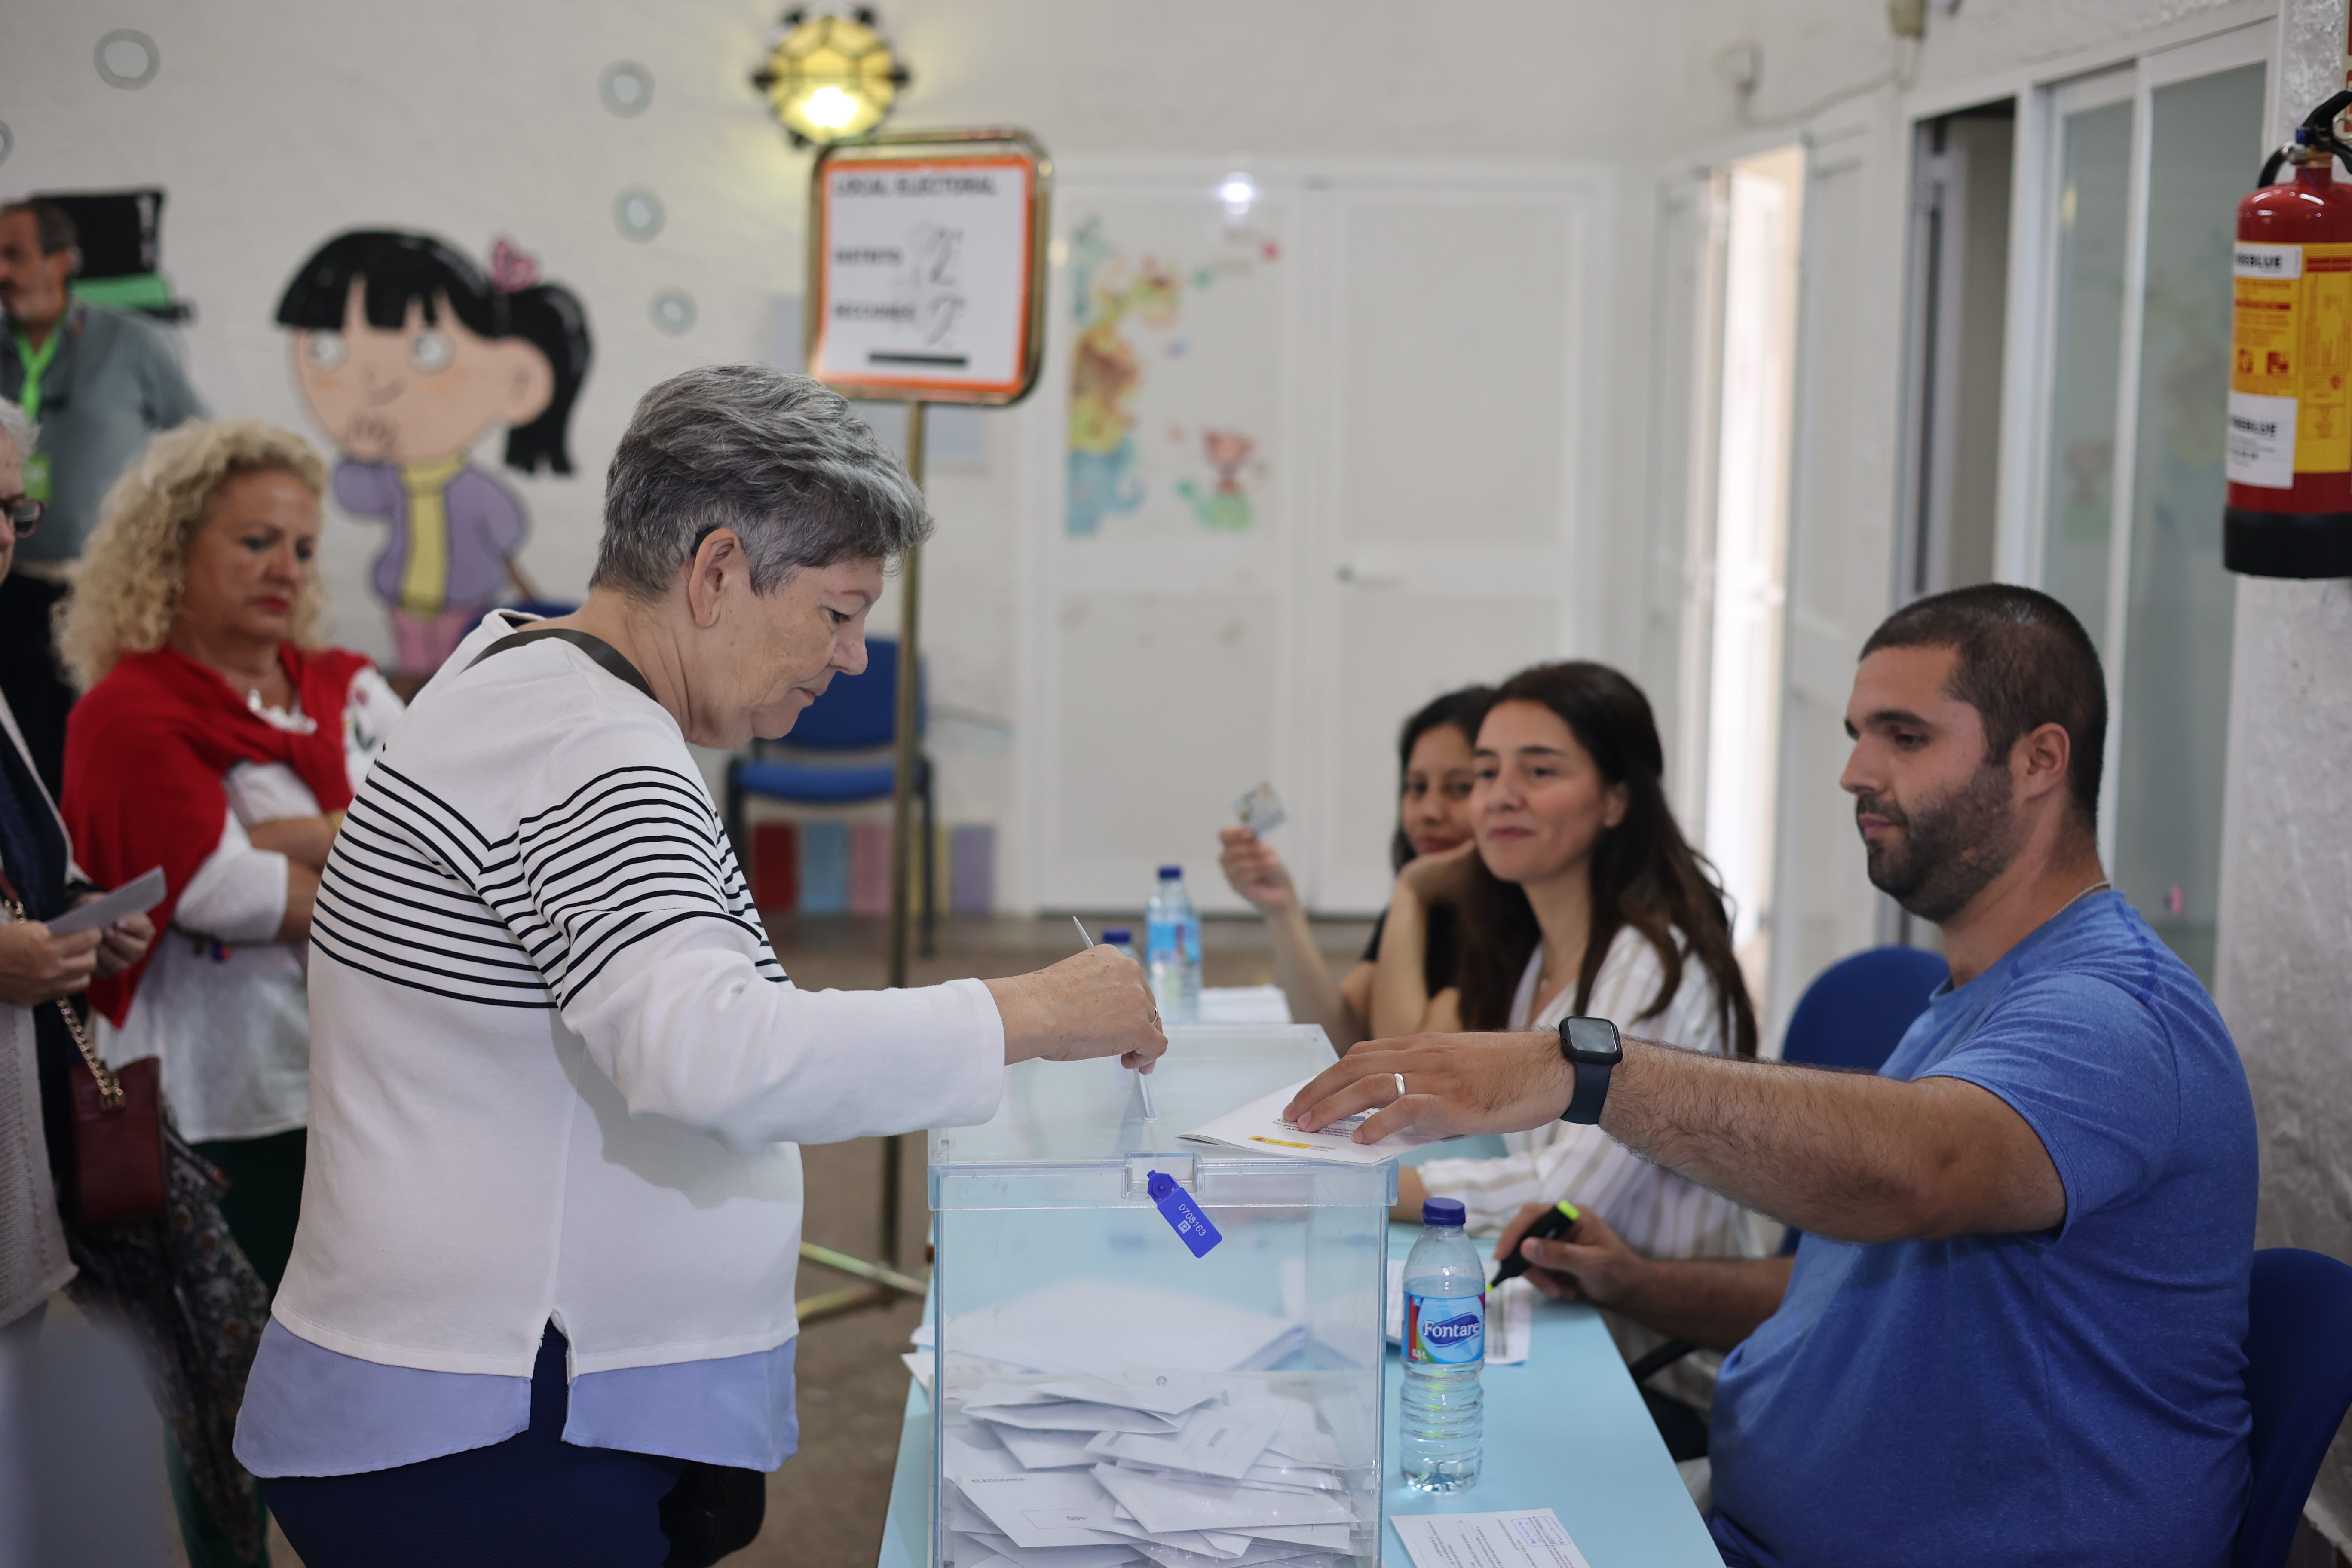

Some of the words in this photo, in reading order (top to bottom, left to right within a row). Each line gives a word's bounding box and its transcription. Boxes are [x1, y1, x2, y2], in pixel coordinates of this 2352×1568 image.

[895, 174, 998, 196] ELECTORAL
[1179, 1204, 1206, 1236] 0708163
[1422, 1316, 1482, 1338] Fontarel
